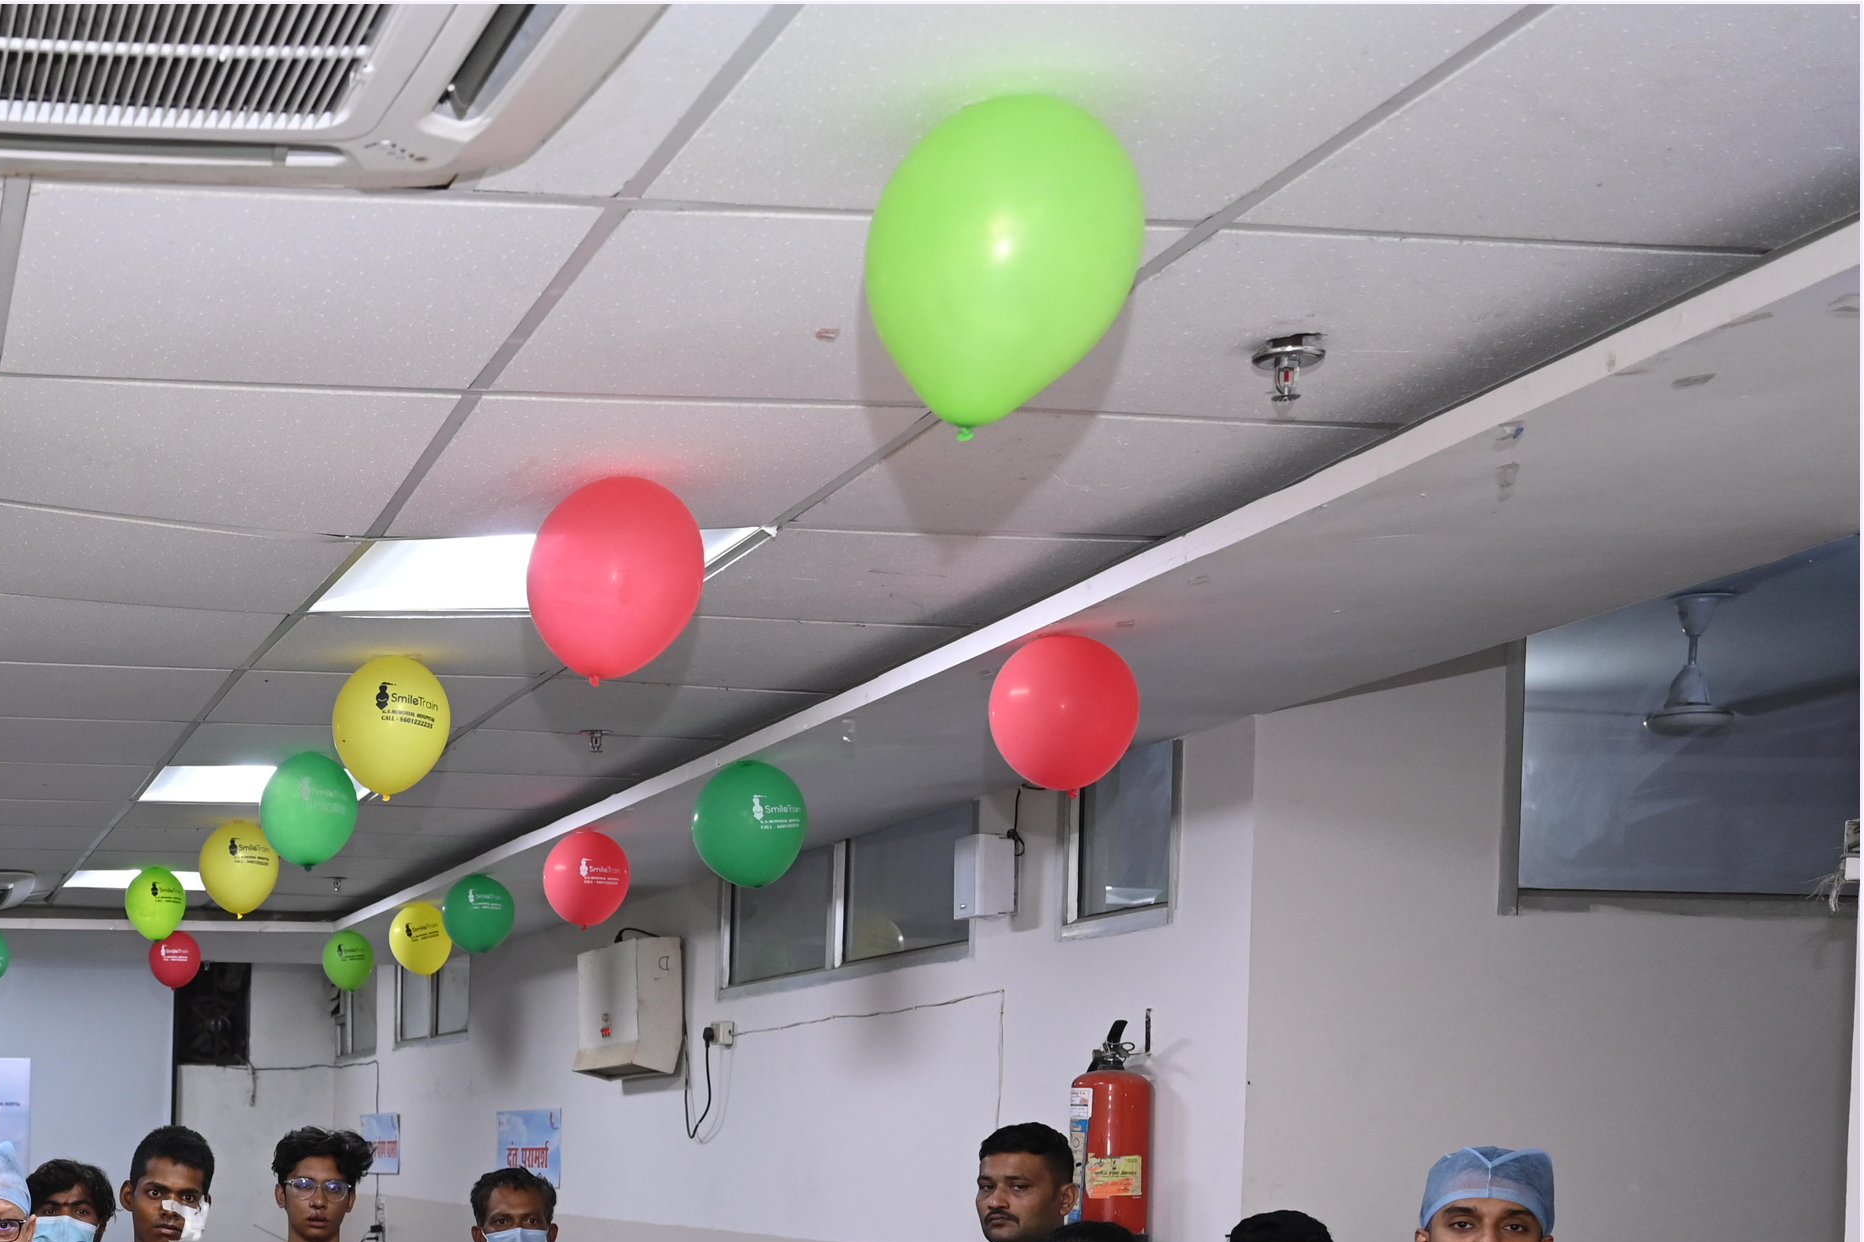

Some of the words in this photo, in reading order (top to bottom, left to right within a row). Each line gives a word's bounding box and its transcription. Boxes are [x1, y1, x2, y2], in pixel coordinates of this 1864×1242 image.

[391, 693, 438, 711] SmileTrain
[417, 713, 435, 722] HOSPITAL
[521, 1140, 549, 1168] परामर्श
